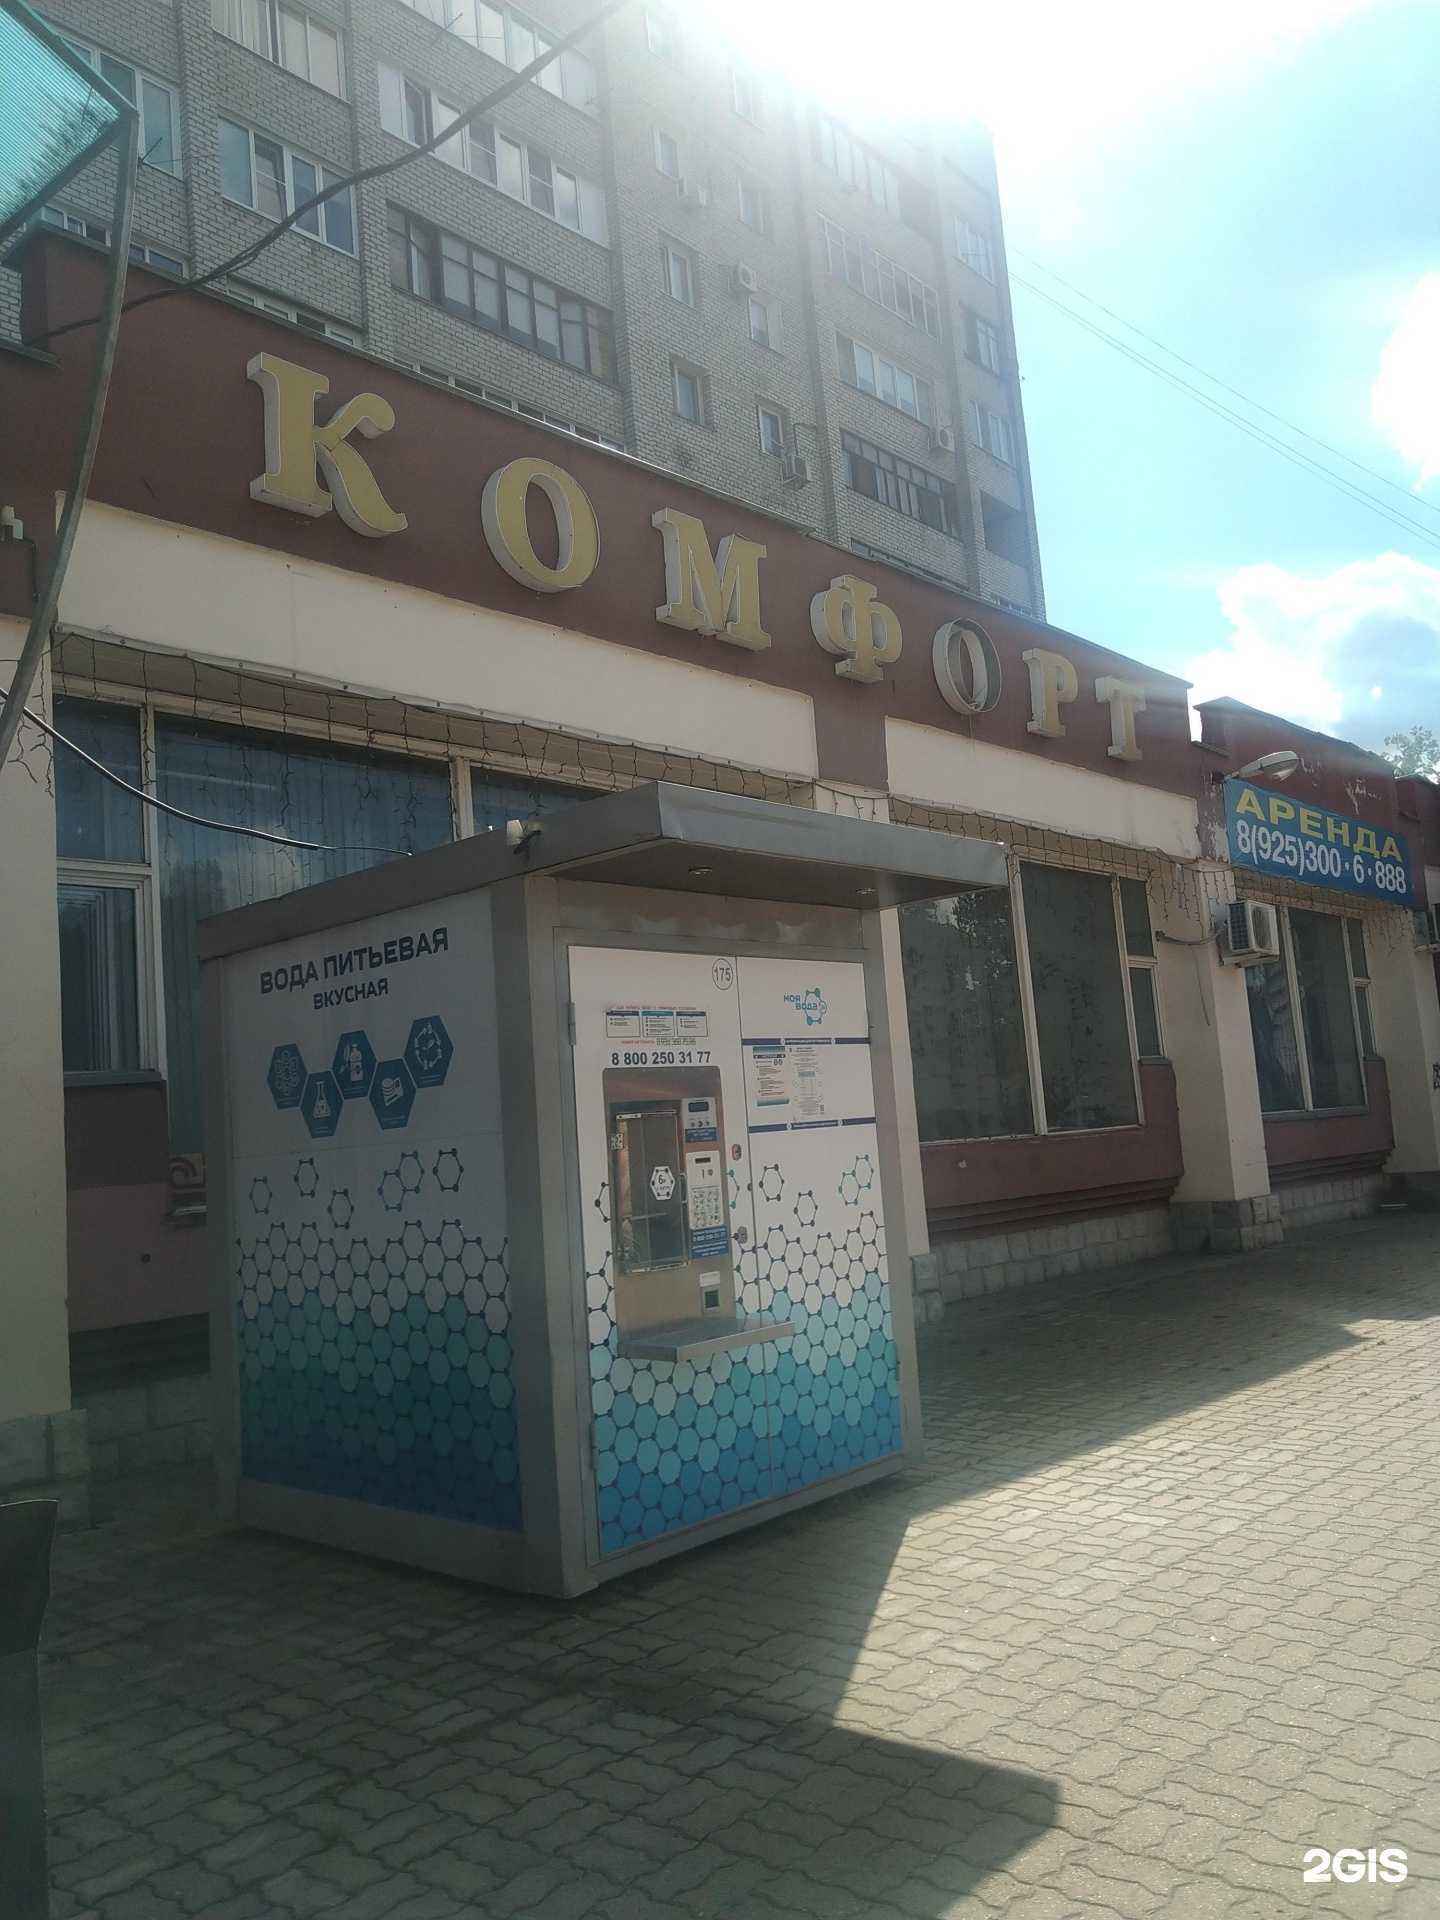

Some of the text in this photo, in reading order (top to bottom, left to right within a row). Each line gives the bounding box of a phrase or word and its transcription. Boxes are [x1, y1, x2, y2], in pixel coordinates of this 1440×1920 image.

[246, 352, 1148, 762] КОМФОРТ
[1235, 787, 1404, 862] АРЕНДА
[260, 927, 449, 994] ВОДА ПИТЬЕВАЯ
[713, 967, 731, 982] 175
[313, 978, 389, 1010] ВКУСНАЯ
[611, 1051, 712, 1066] 8 800 250 31 77
